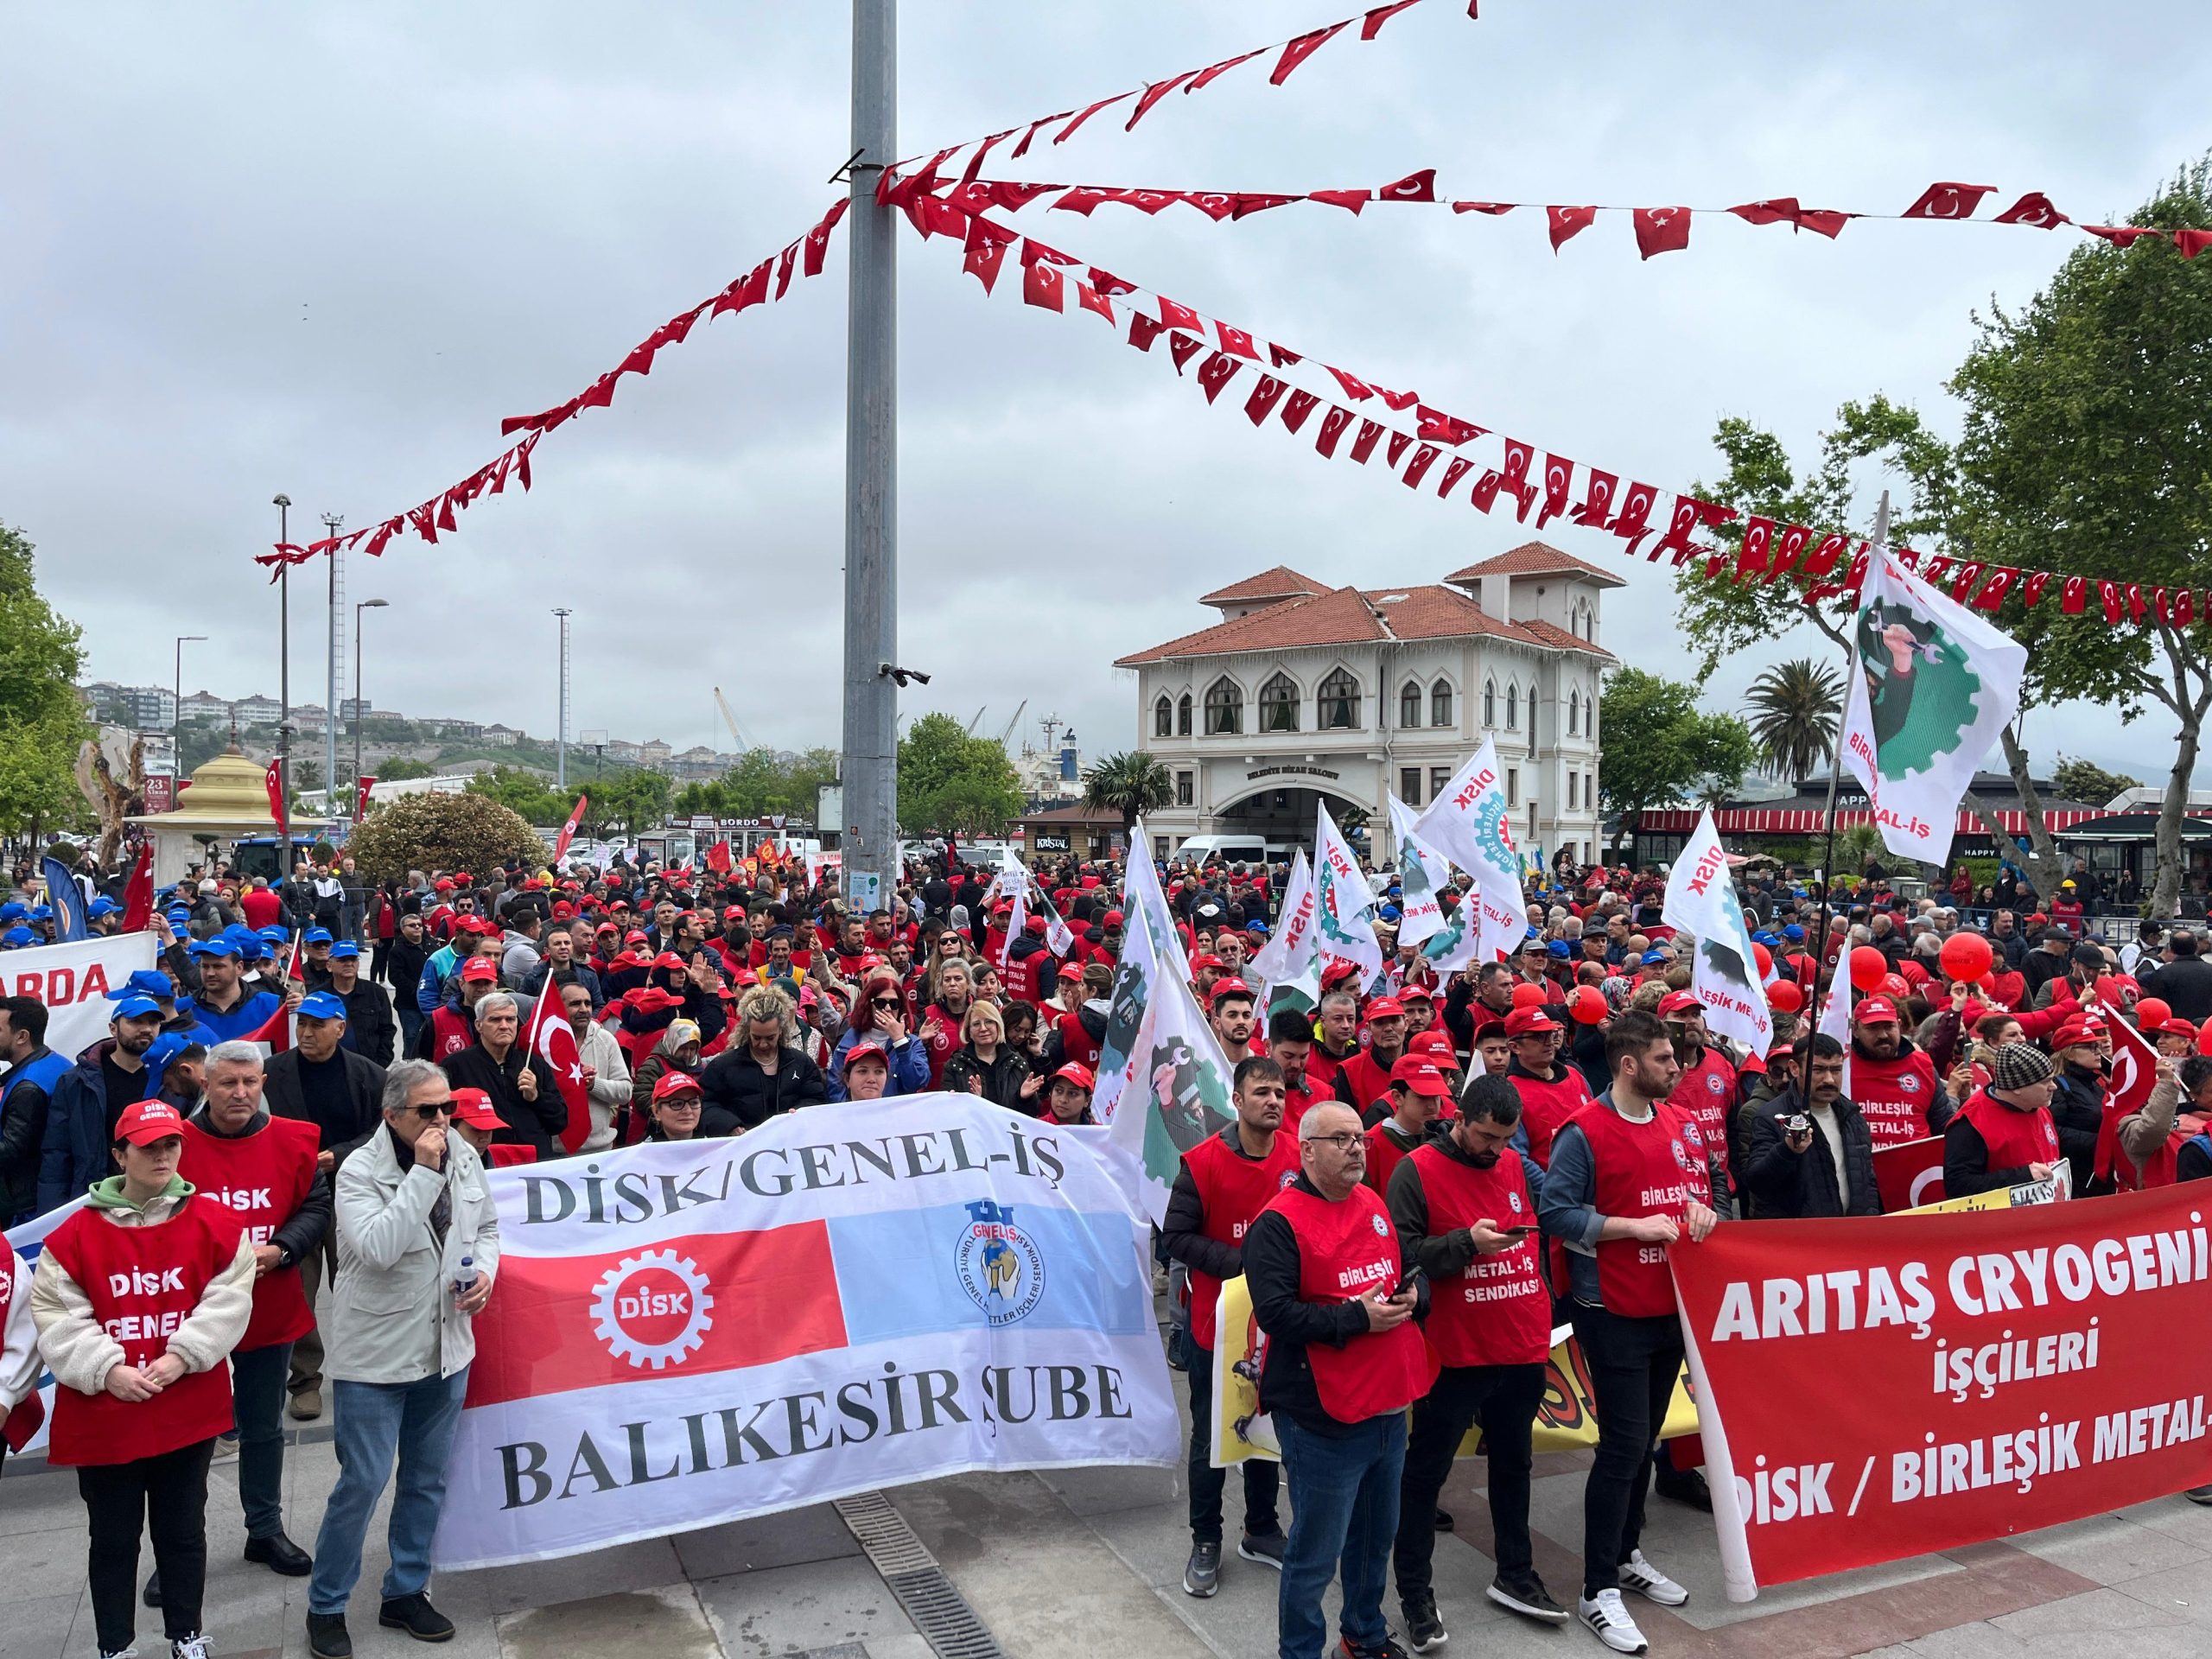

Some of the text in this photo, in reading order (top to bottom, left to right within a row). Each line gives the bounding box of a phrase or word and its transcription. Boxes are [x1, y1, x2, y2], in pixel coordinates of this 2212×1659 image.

[147, 779, 163, 790] 23
[0, 963, 110, 1007] RDA
[144, 1103, 167, 1112] DİSK
[1866, 1121, 1915, 1138] ETAL-İŞ
[519, 1122, 1065, 1225] DİSK/GENEL-İŞ
[960, 1236, 976, 1273] TÜRKİYE
[1016, 1234, 1042, 1281] SENDİKASI
[109, 1265, 185, 1298] DİSK
[963, 1274, 983, 1305] GENEL
[1338, 1256, 1395, 1289] BİRLEŞİK
[1711, 1211, 2212, 1340] ARITAŞ CRYOGENİ
[620, 1286, 688, 1319] DİSK
[1016, 1282, 1041, 1316] İŞÇİLERİ
[1465, 1278, 1540, 1302] SENDİKASI
[1933, 1316, 2099, 1403] İŞÇİLERİ
[494, 1361, 972, 1510] BALIKESİR
[1891, 1412, 2081, 1495] BİRLEŞİK
